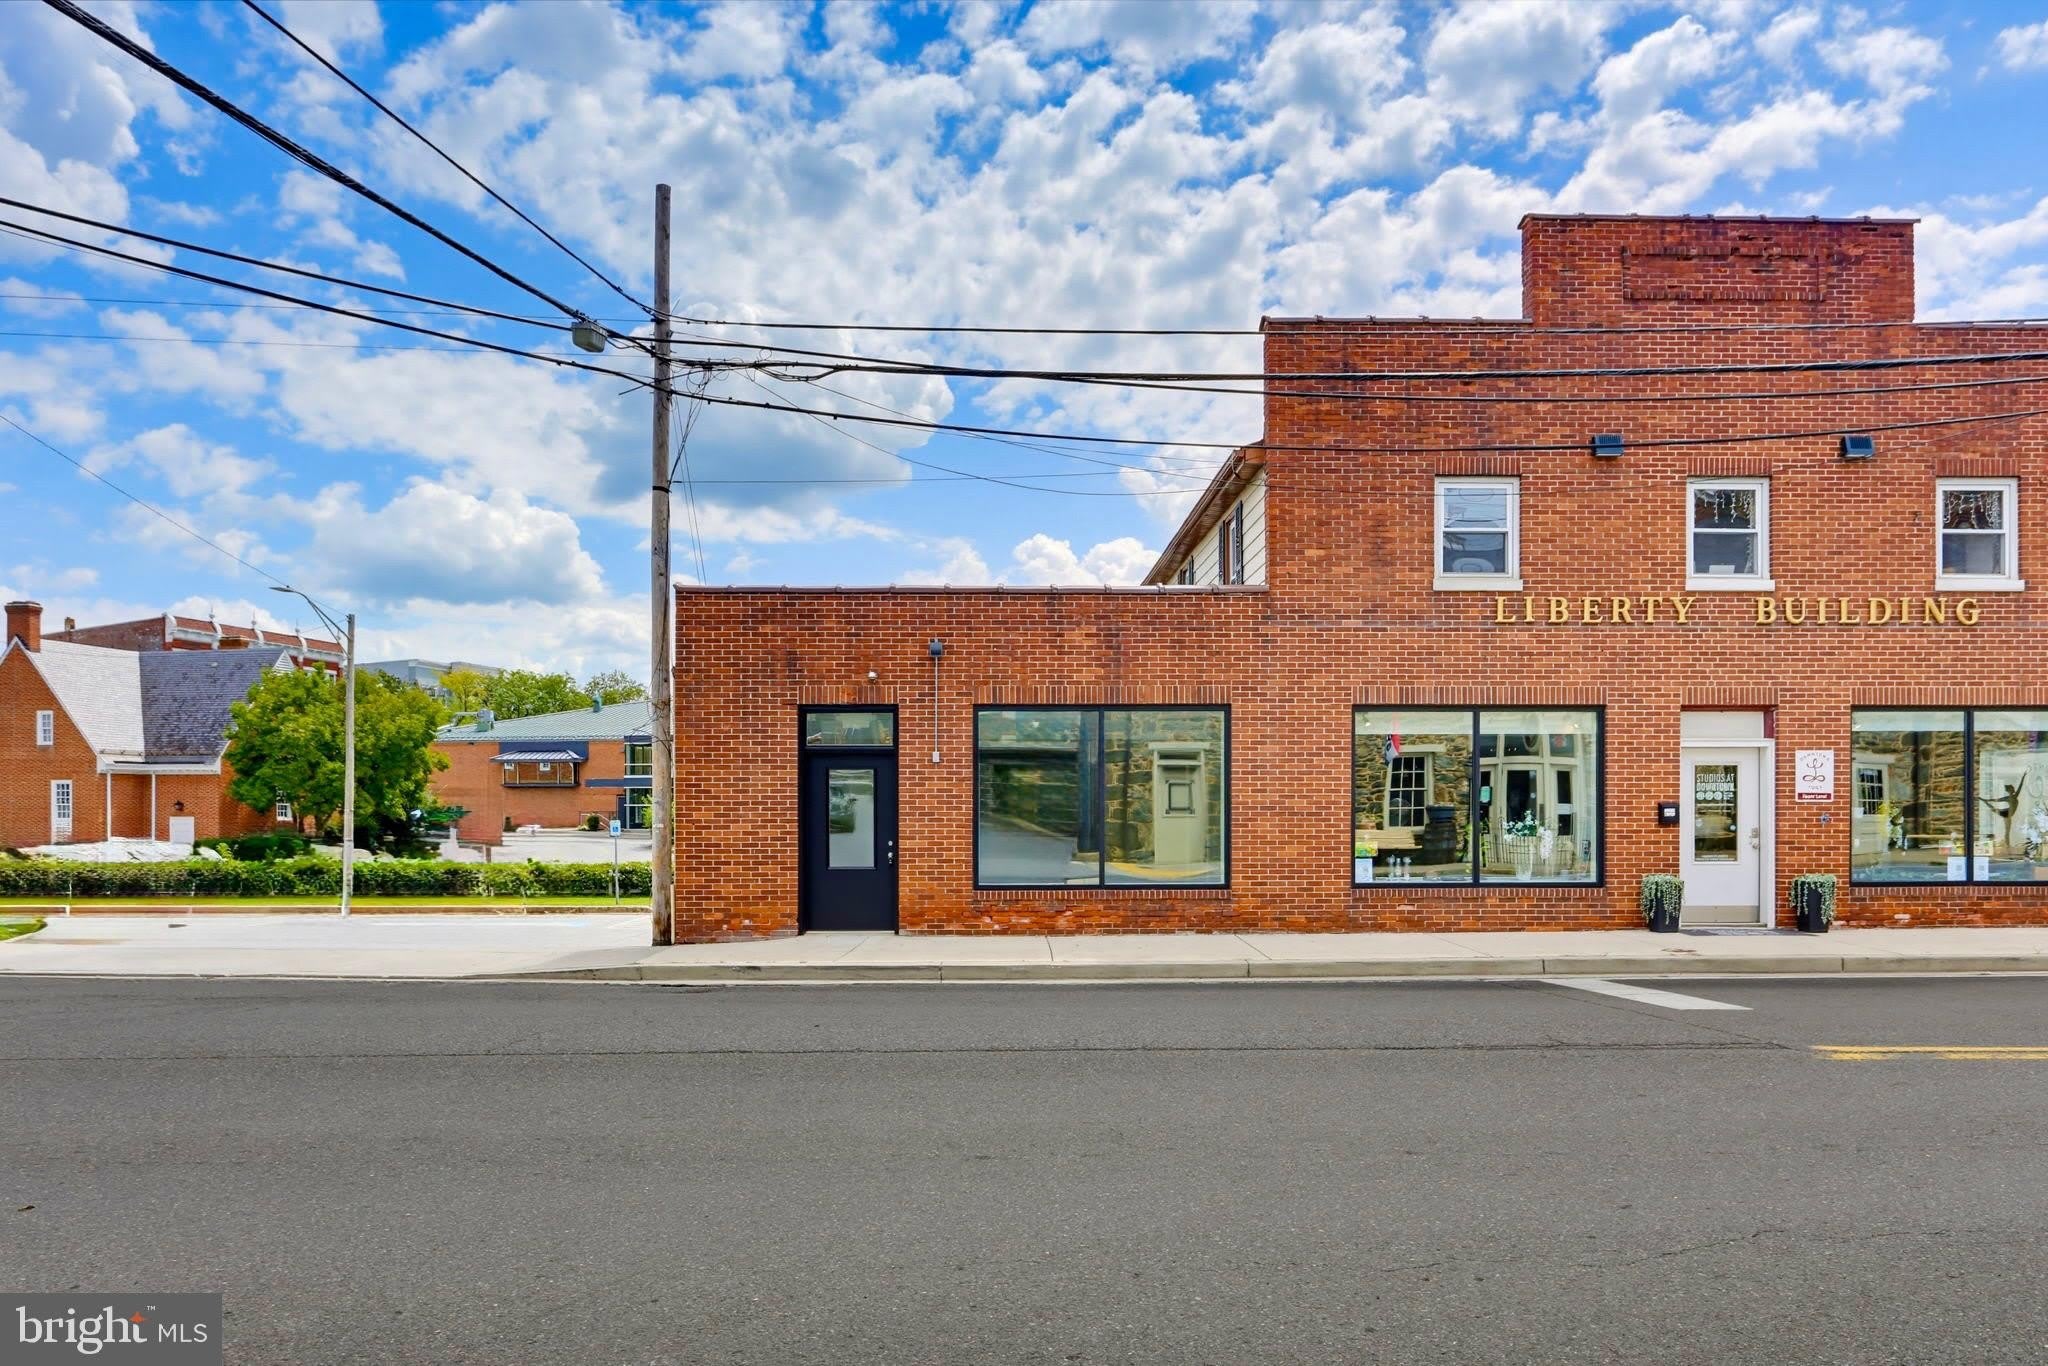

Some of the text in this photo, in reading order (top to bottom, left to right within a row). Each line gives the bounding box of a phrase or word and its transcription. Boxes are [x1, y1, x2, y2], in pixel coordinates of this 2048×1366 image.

[1494, 596, 1983, 626] LIBERTY BUILDING
[1696, 773, 1735, 783] STUDIOS AT
